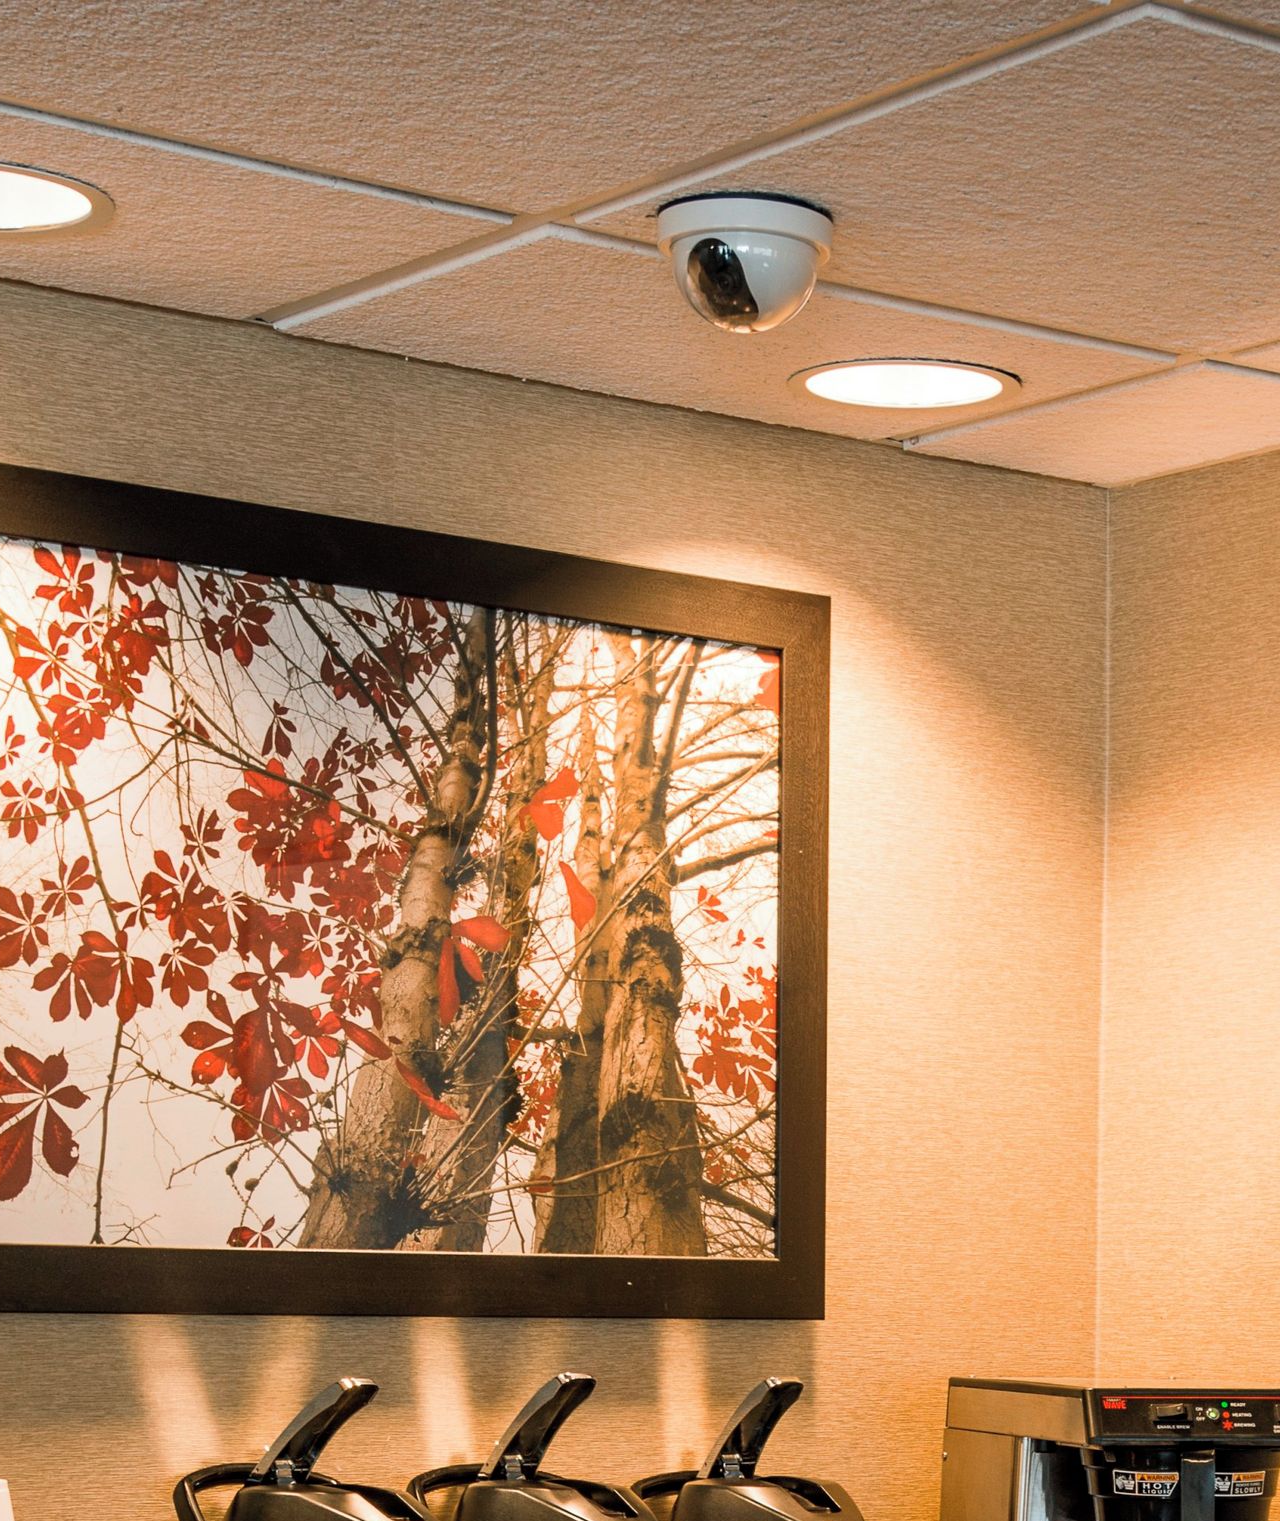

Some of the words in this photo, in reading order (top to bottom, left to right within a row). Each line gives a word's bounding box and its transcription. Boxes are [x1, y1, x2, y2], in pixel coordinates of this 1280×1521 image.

[1103, 1400, 1127, 1410] WAVE
[1142, 1482, 1172, 1490] HOT
[1234, 1486, 1261, 1494] SLOWLY
